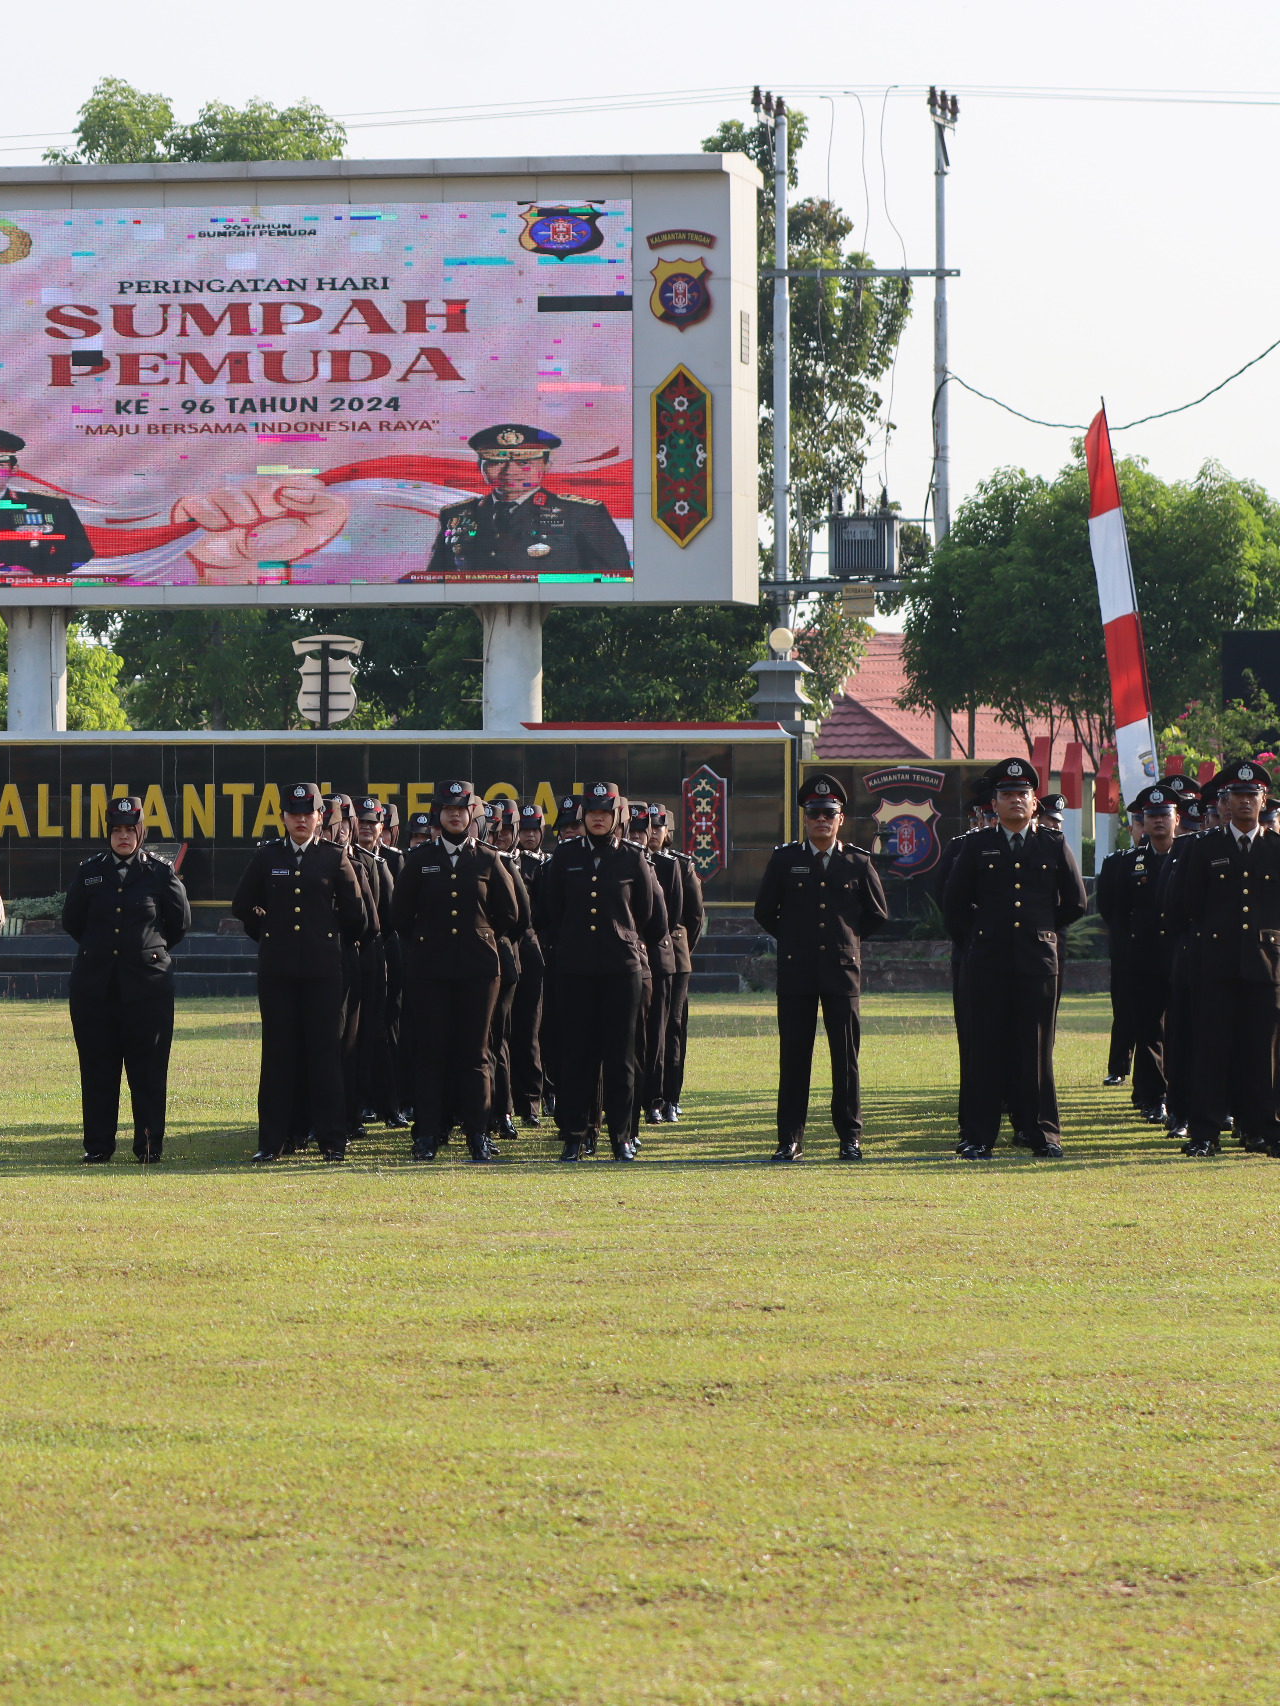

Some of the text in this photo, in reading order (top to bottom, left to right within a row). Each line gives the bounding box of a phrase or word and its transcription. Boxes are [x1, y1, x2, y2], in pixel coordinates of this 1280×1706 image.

[198, 229, 317, 238] SUMPAH PEMUDA
[649, 232, 711, 245] KALIMANTAN TENGAH
[117, 276, 390, 294] PERINGATAN HARI
[44, 298, 470, 339] SUMPAH
[47, 347, 466, 387] PEMUDA
[115, 399, 150, 415] KE
[181, 399, 215, 414] 96
[225, 396, 318, 414] TAHUN
[330, 396, 401, 412] 2024
[147, 422, 248, 435] BERSAMA
[255, 420, 371, 433] INDONESIA
[868, 773, 939, 787] KALIMANTAN TENGAH
